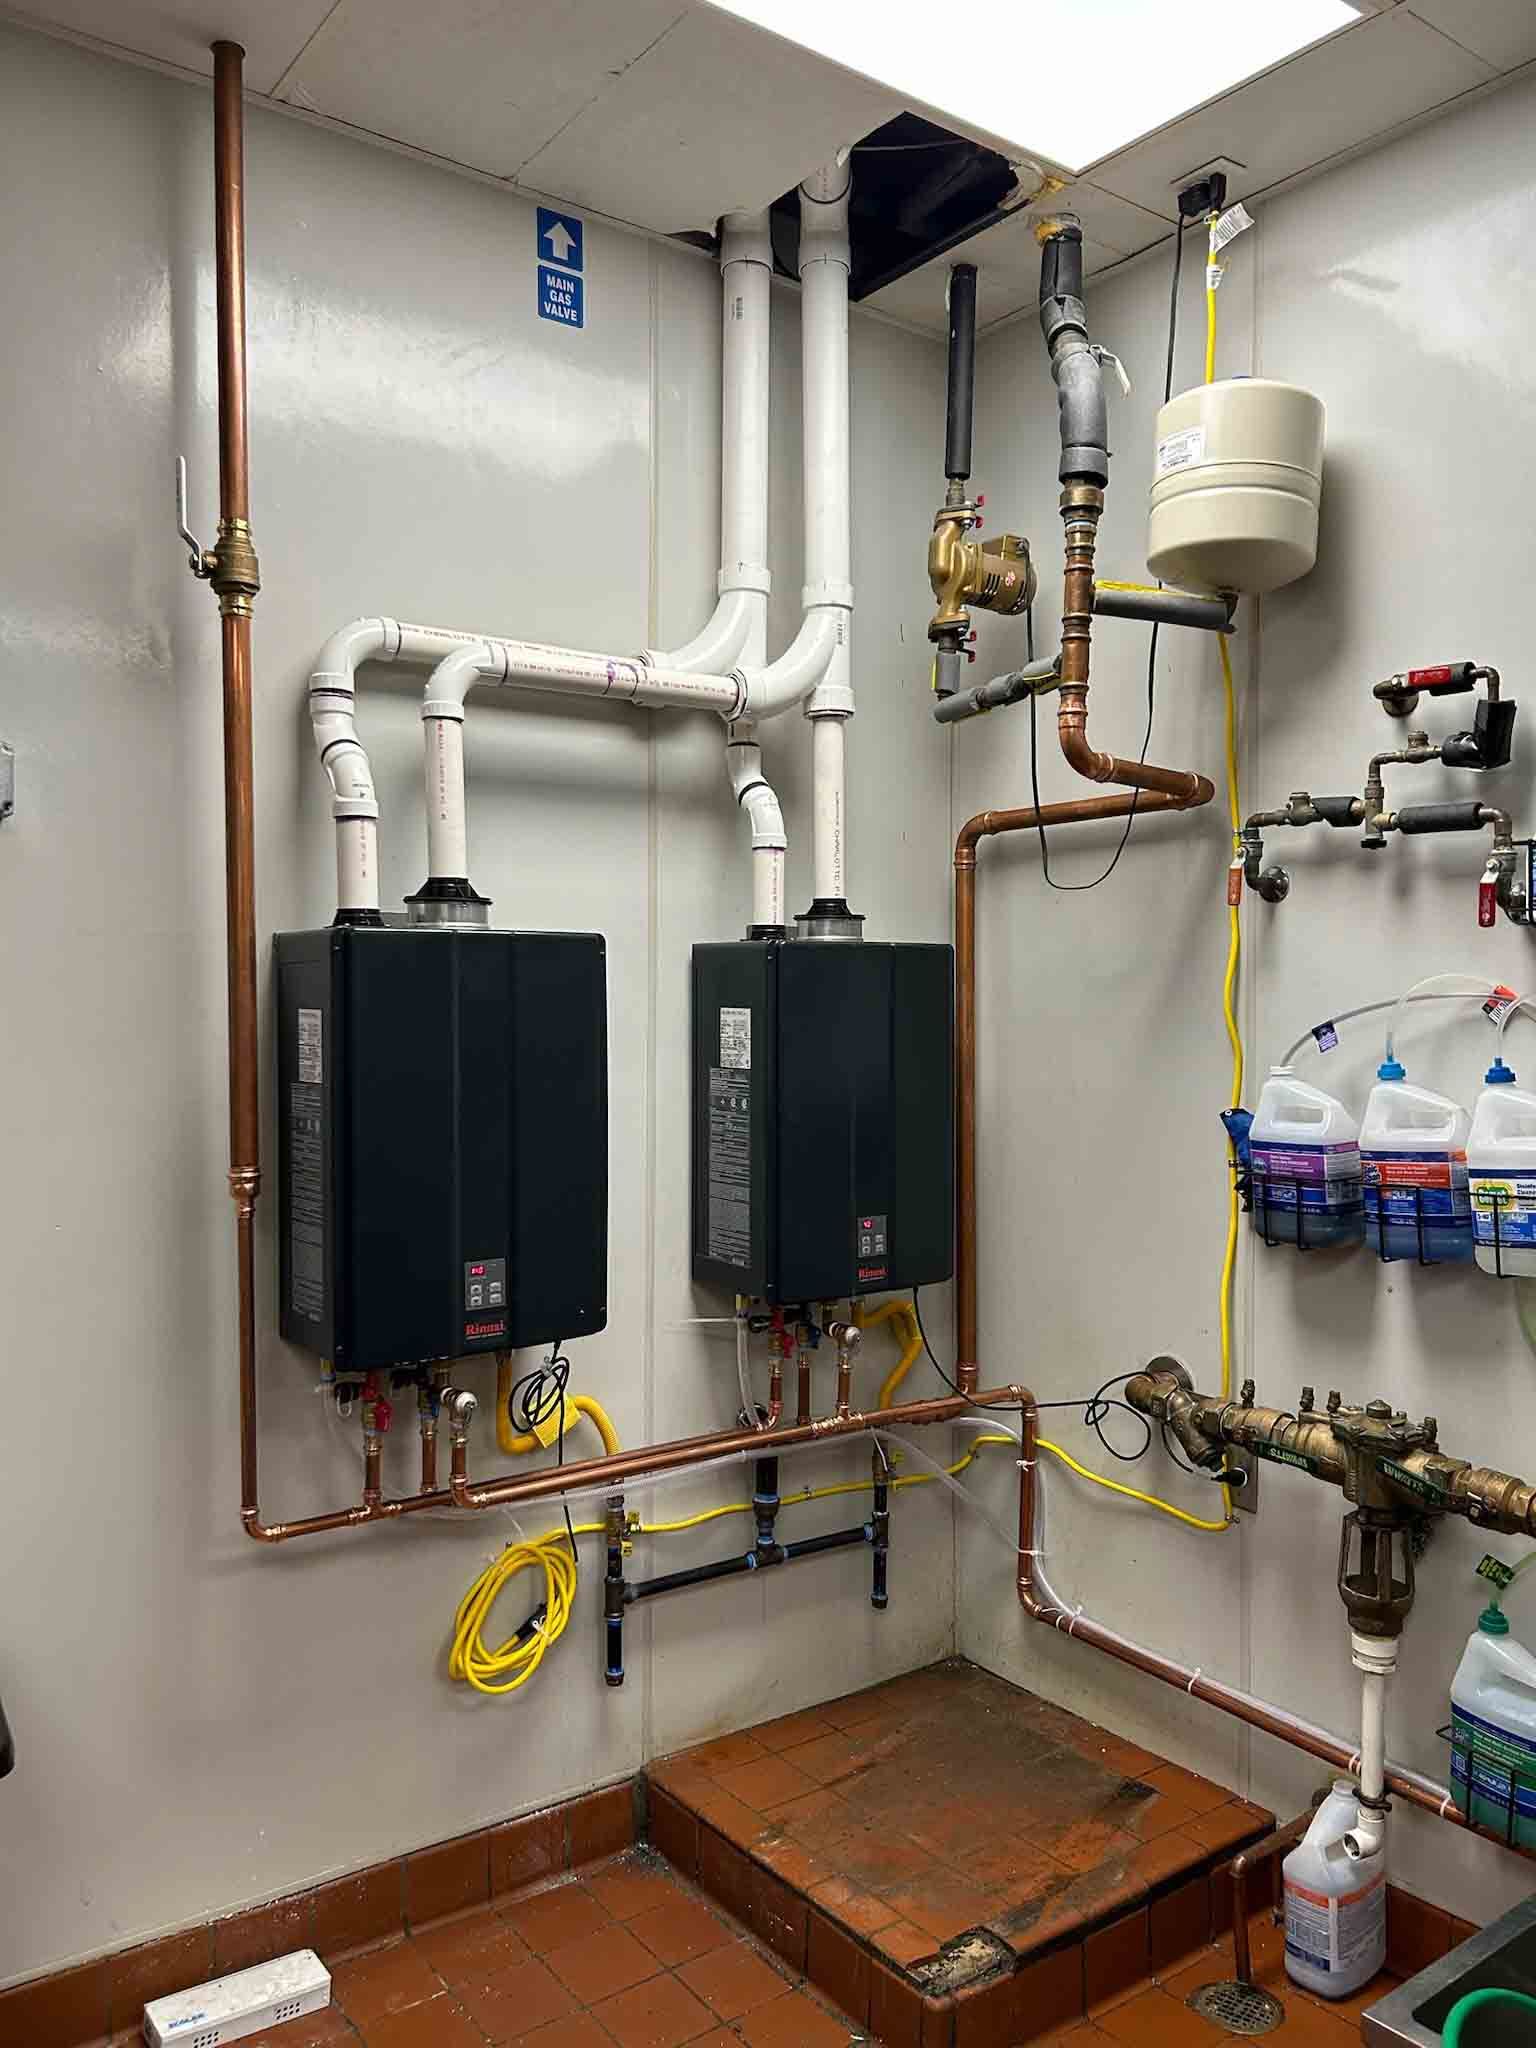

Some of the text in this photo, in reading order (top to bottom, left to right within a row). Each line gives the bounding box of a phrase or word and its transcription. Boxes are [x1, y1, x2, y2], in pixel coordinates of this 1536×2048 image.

[546, 274, 574, 294] MAIN
[549, 290, 572, 306] GAS
[543, 301, 578, 321] VALVE
